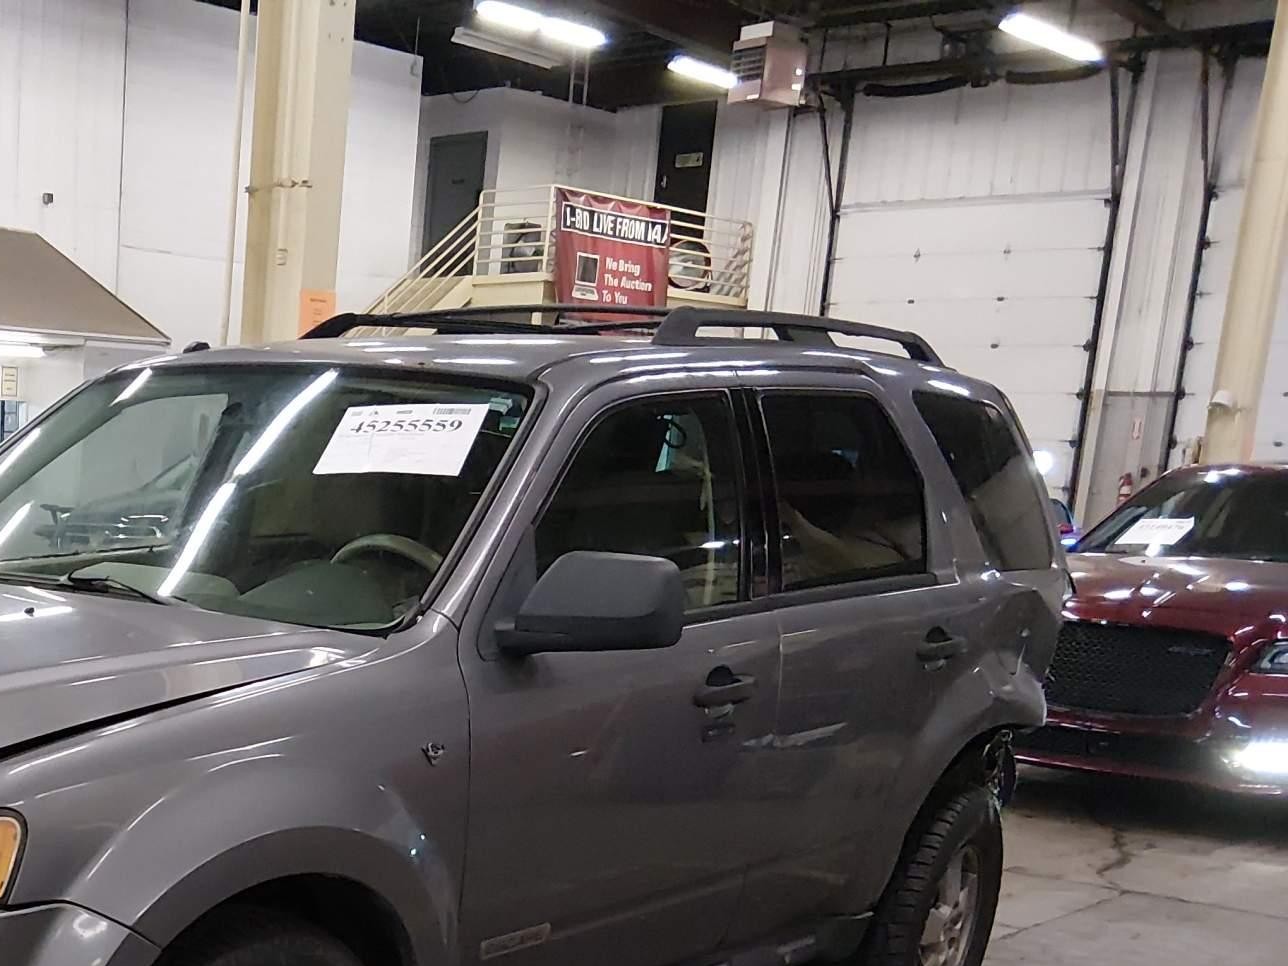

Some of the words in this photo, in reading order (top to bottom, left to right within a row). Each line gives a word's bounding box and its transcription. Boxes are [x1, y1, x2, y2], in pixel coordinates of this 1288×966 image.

[593, 213, 615, 235] LIVE
[616, 218, 645, 240] FROM
[618, 261, 640, 276] Bring
[604, 274, 618, 287] The
[621, 277, 652, 291] Auction
[602, 290, 612, 303] To
[614, 292, 627, 304] You
[350, 419, 463, 433] 45255559
